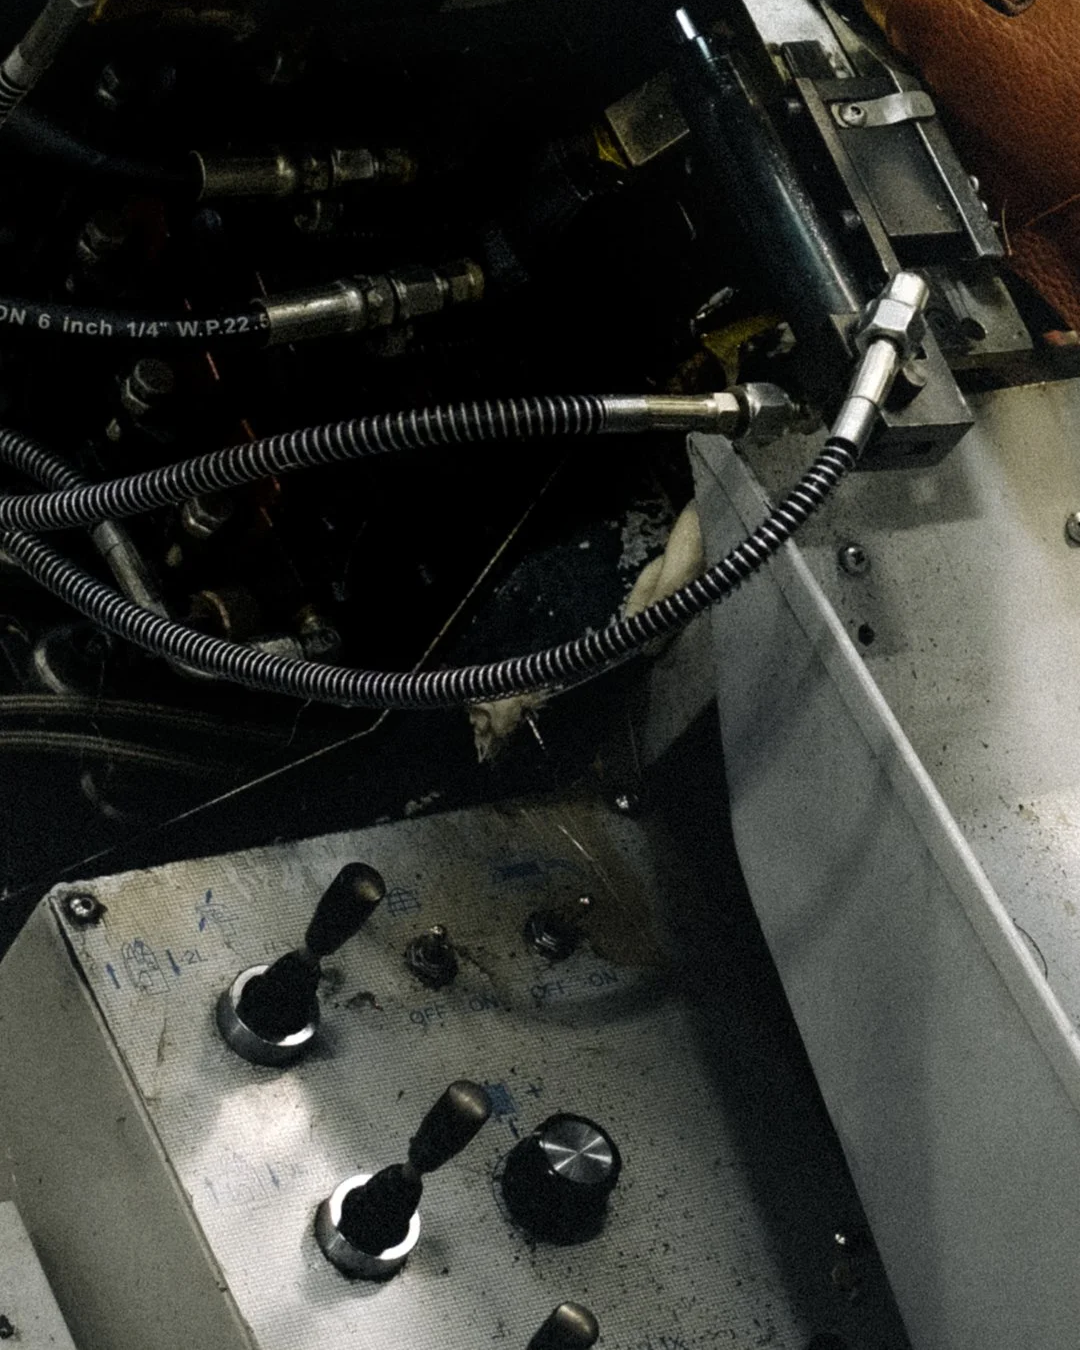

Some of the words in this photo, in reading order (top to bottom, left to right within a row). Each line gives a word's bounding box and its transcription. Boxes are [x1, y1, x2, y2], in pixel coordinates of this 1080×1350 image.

[38, 314, 51, 329] 6
[63, 316, 112, 336] inch
[127, 321, 167, 338] 1/4"
[590, 970, 617, 987] ON
[410, 1004, 444, 1025] OFF
[469, 993, 499, 1012] ON
